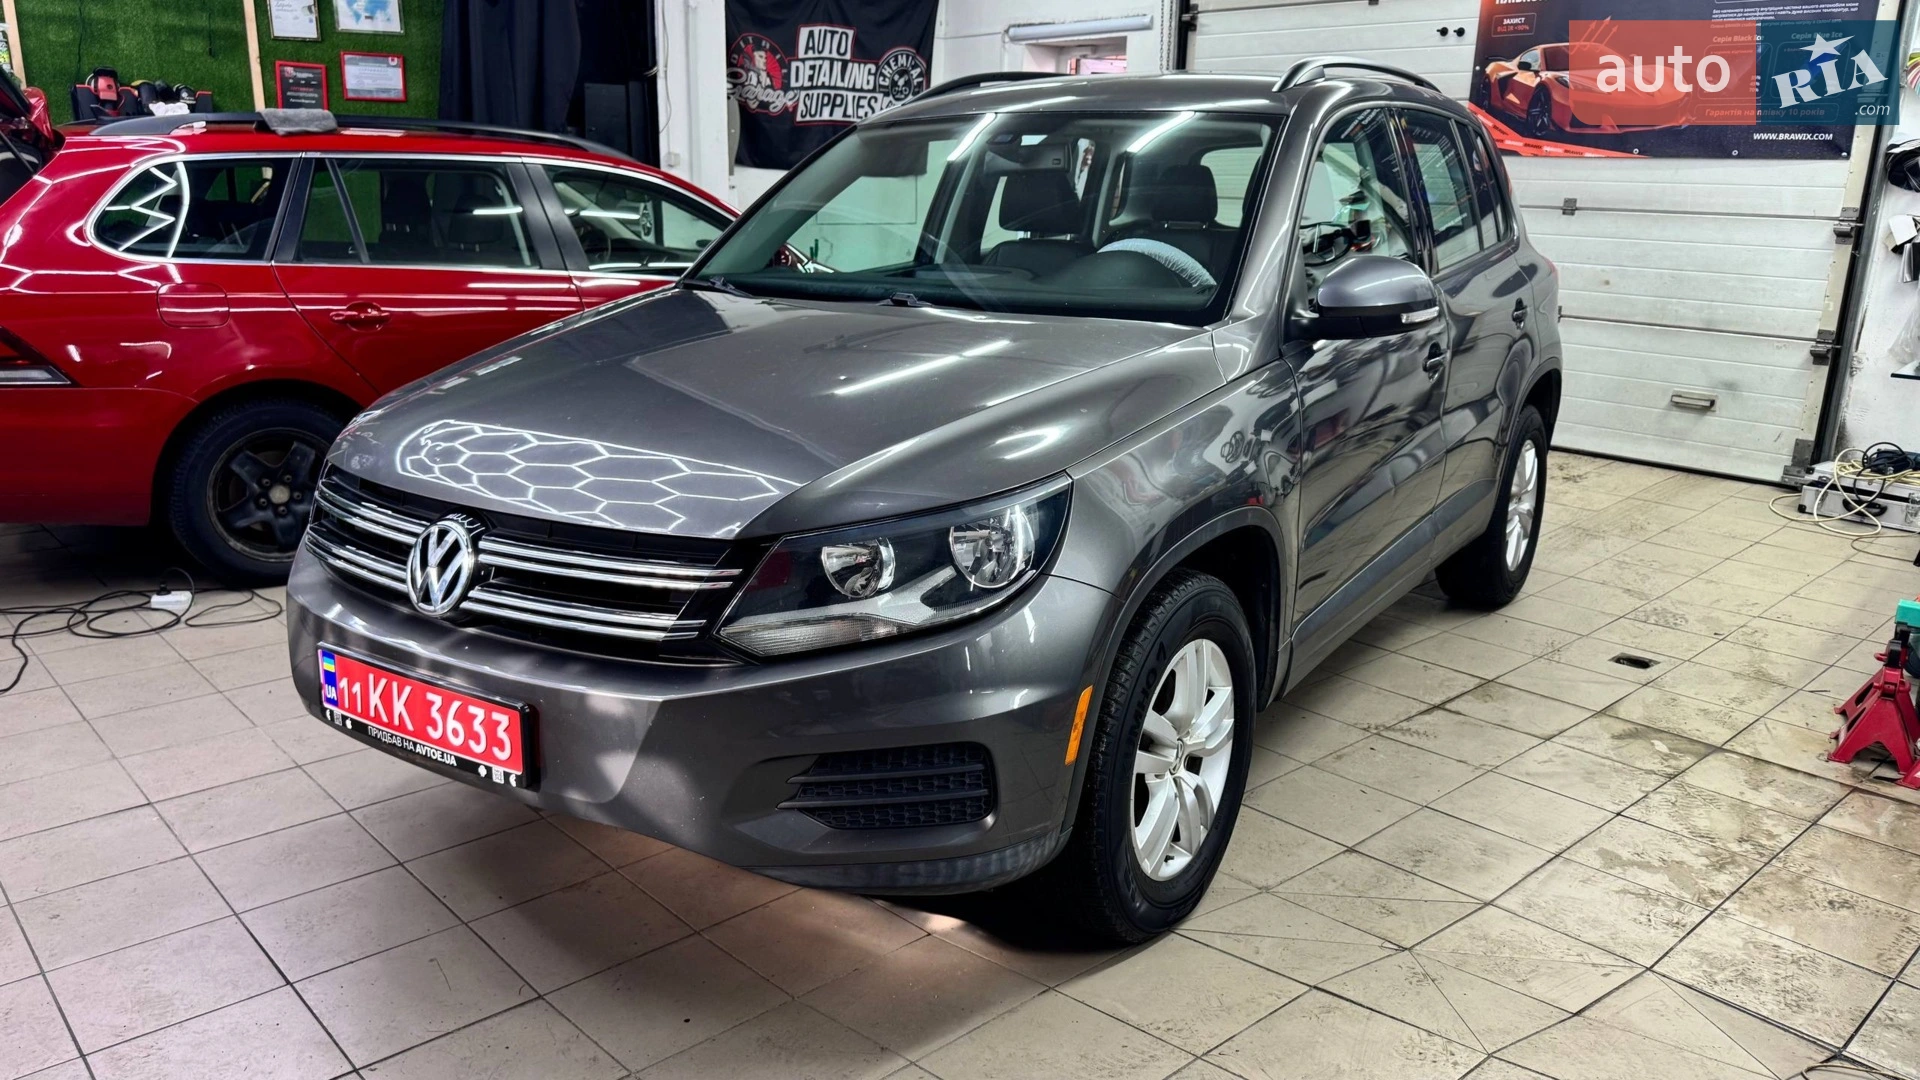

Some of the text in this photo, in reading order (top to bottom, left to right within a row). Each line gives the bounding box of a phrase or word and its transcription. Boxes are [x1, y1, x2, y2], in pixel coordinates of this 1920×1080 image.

[803, 28, 850, 56] AUTO
[790, 60, 876, 91] DETAILING
[800, 92, 878, 119] SUPPLIES
[1753, 132, 1833, 141] WWW.BRAWIX.COM
[325, 683, 337, 701] UA
[426, 692, 512, 761] 3633
[367, 725, 457, 767] ПРИДБАВ НА AVTOE.UA
